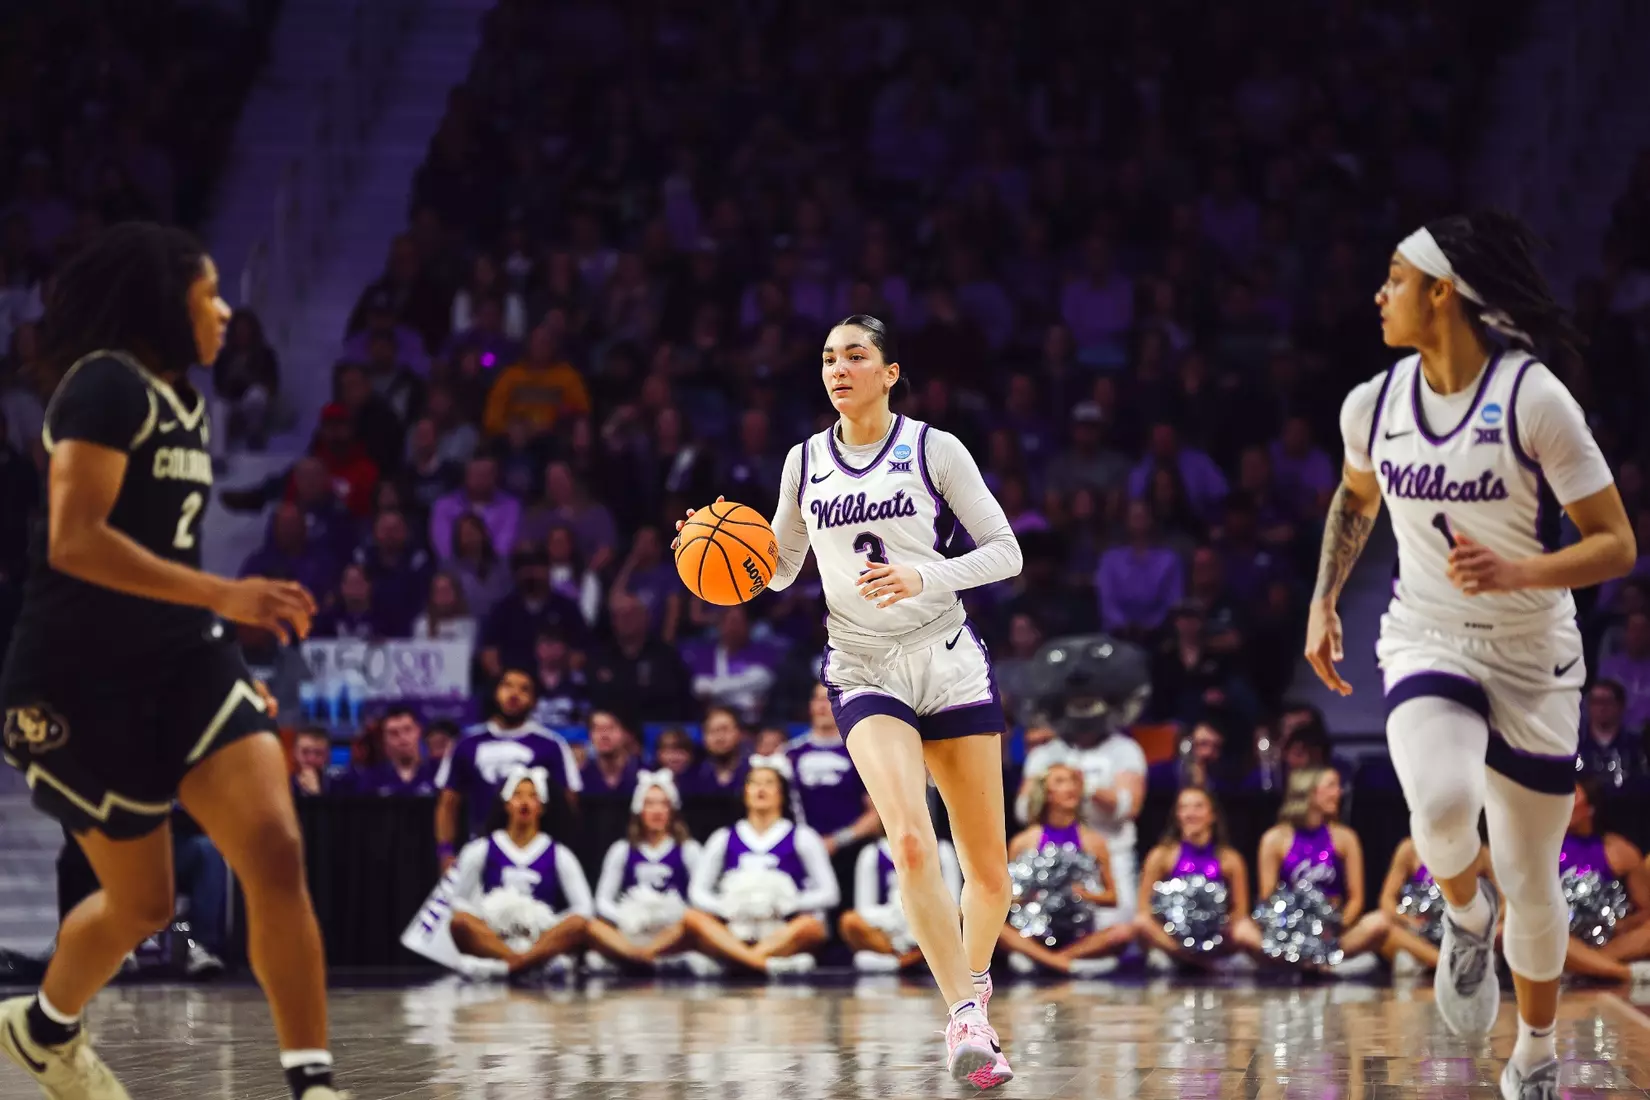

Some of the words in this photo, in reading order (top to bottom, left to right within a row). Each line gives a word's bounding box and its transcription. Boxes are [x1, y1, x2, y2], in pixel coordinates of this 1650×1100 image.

[1380, 460, 1510, 503] Wildcats
[172, 491, 202, 549] 2
[810, 489, 918, 530] Wildcats
